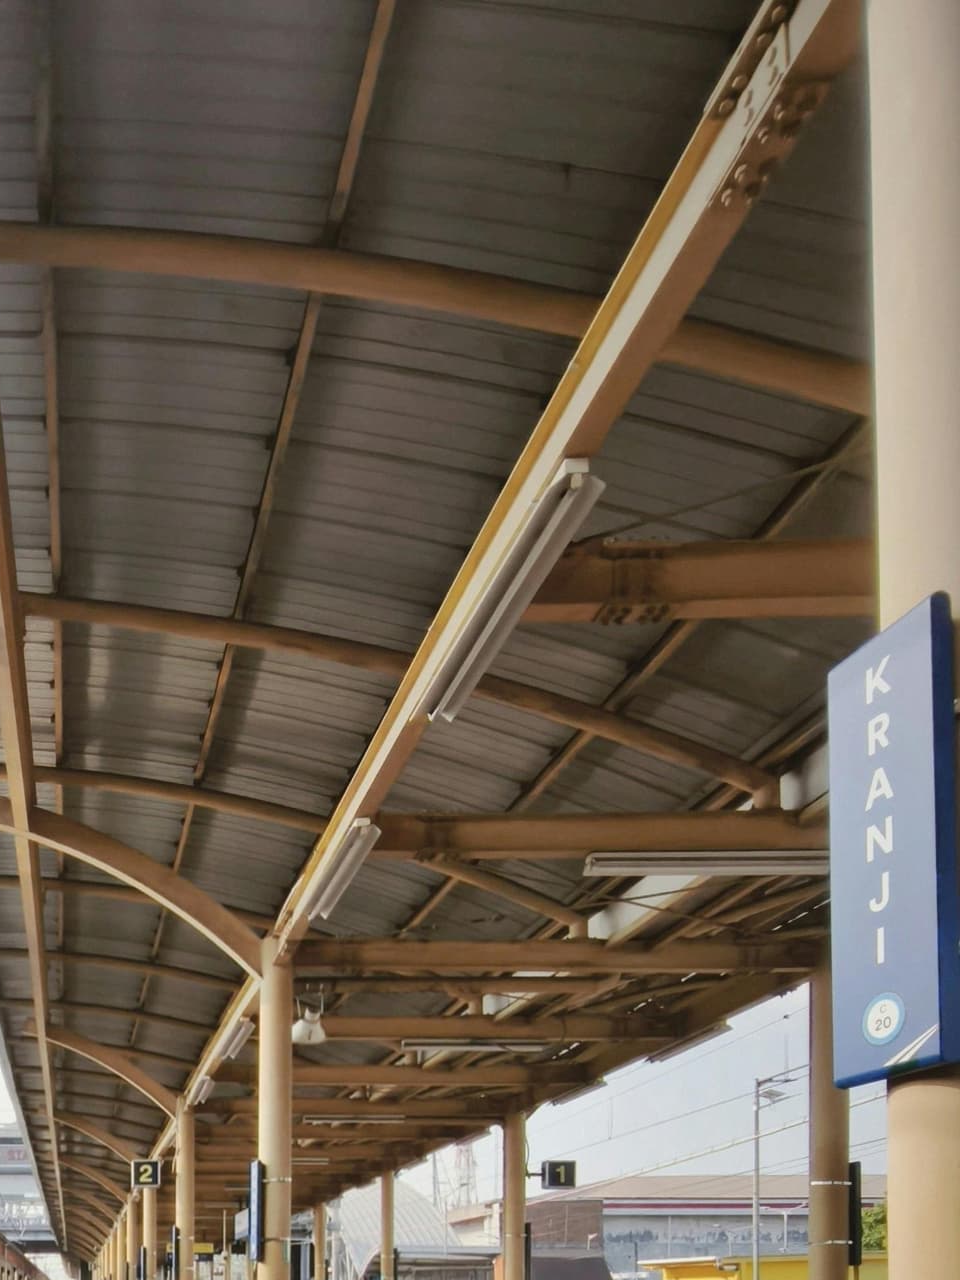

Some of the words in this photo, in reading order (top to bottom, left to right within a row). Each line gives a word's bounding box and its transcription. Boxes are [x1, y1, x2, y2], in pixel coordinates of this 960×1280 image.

[864, 653, 895, 966] KRANJI
[874, 1016, 892, 1032] 20
[139, 1164, 153, 1183] 2
[555, 1165, 566, 1184] 1
